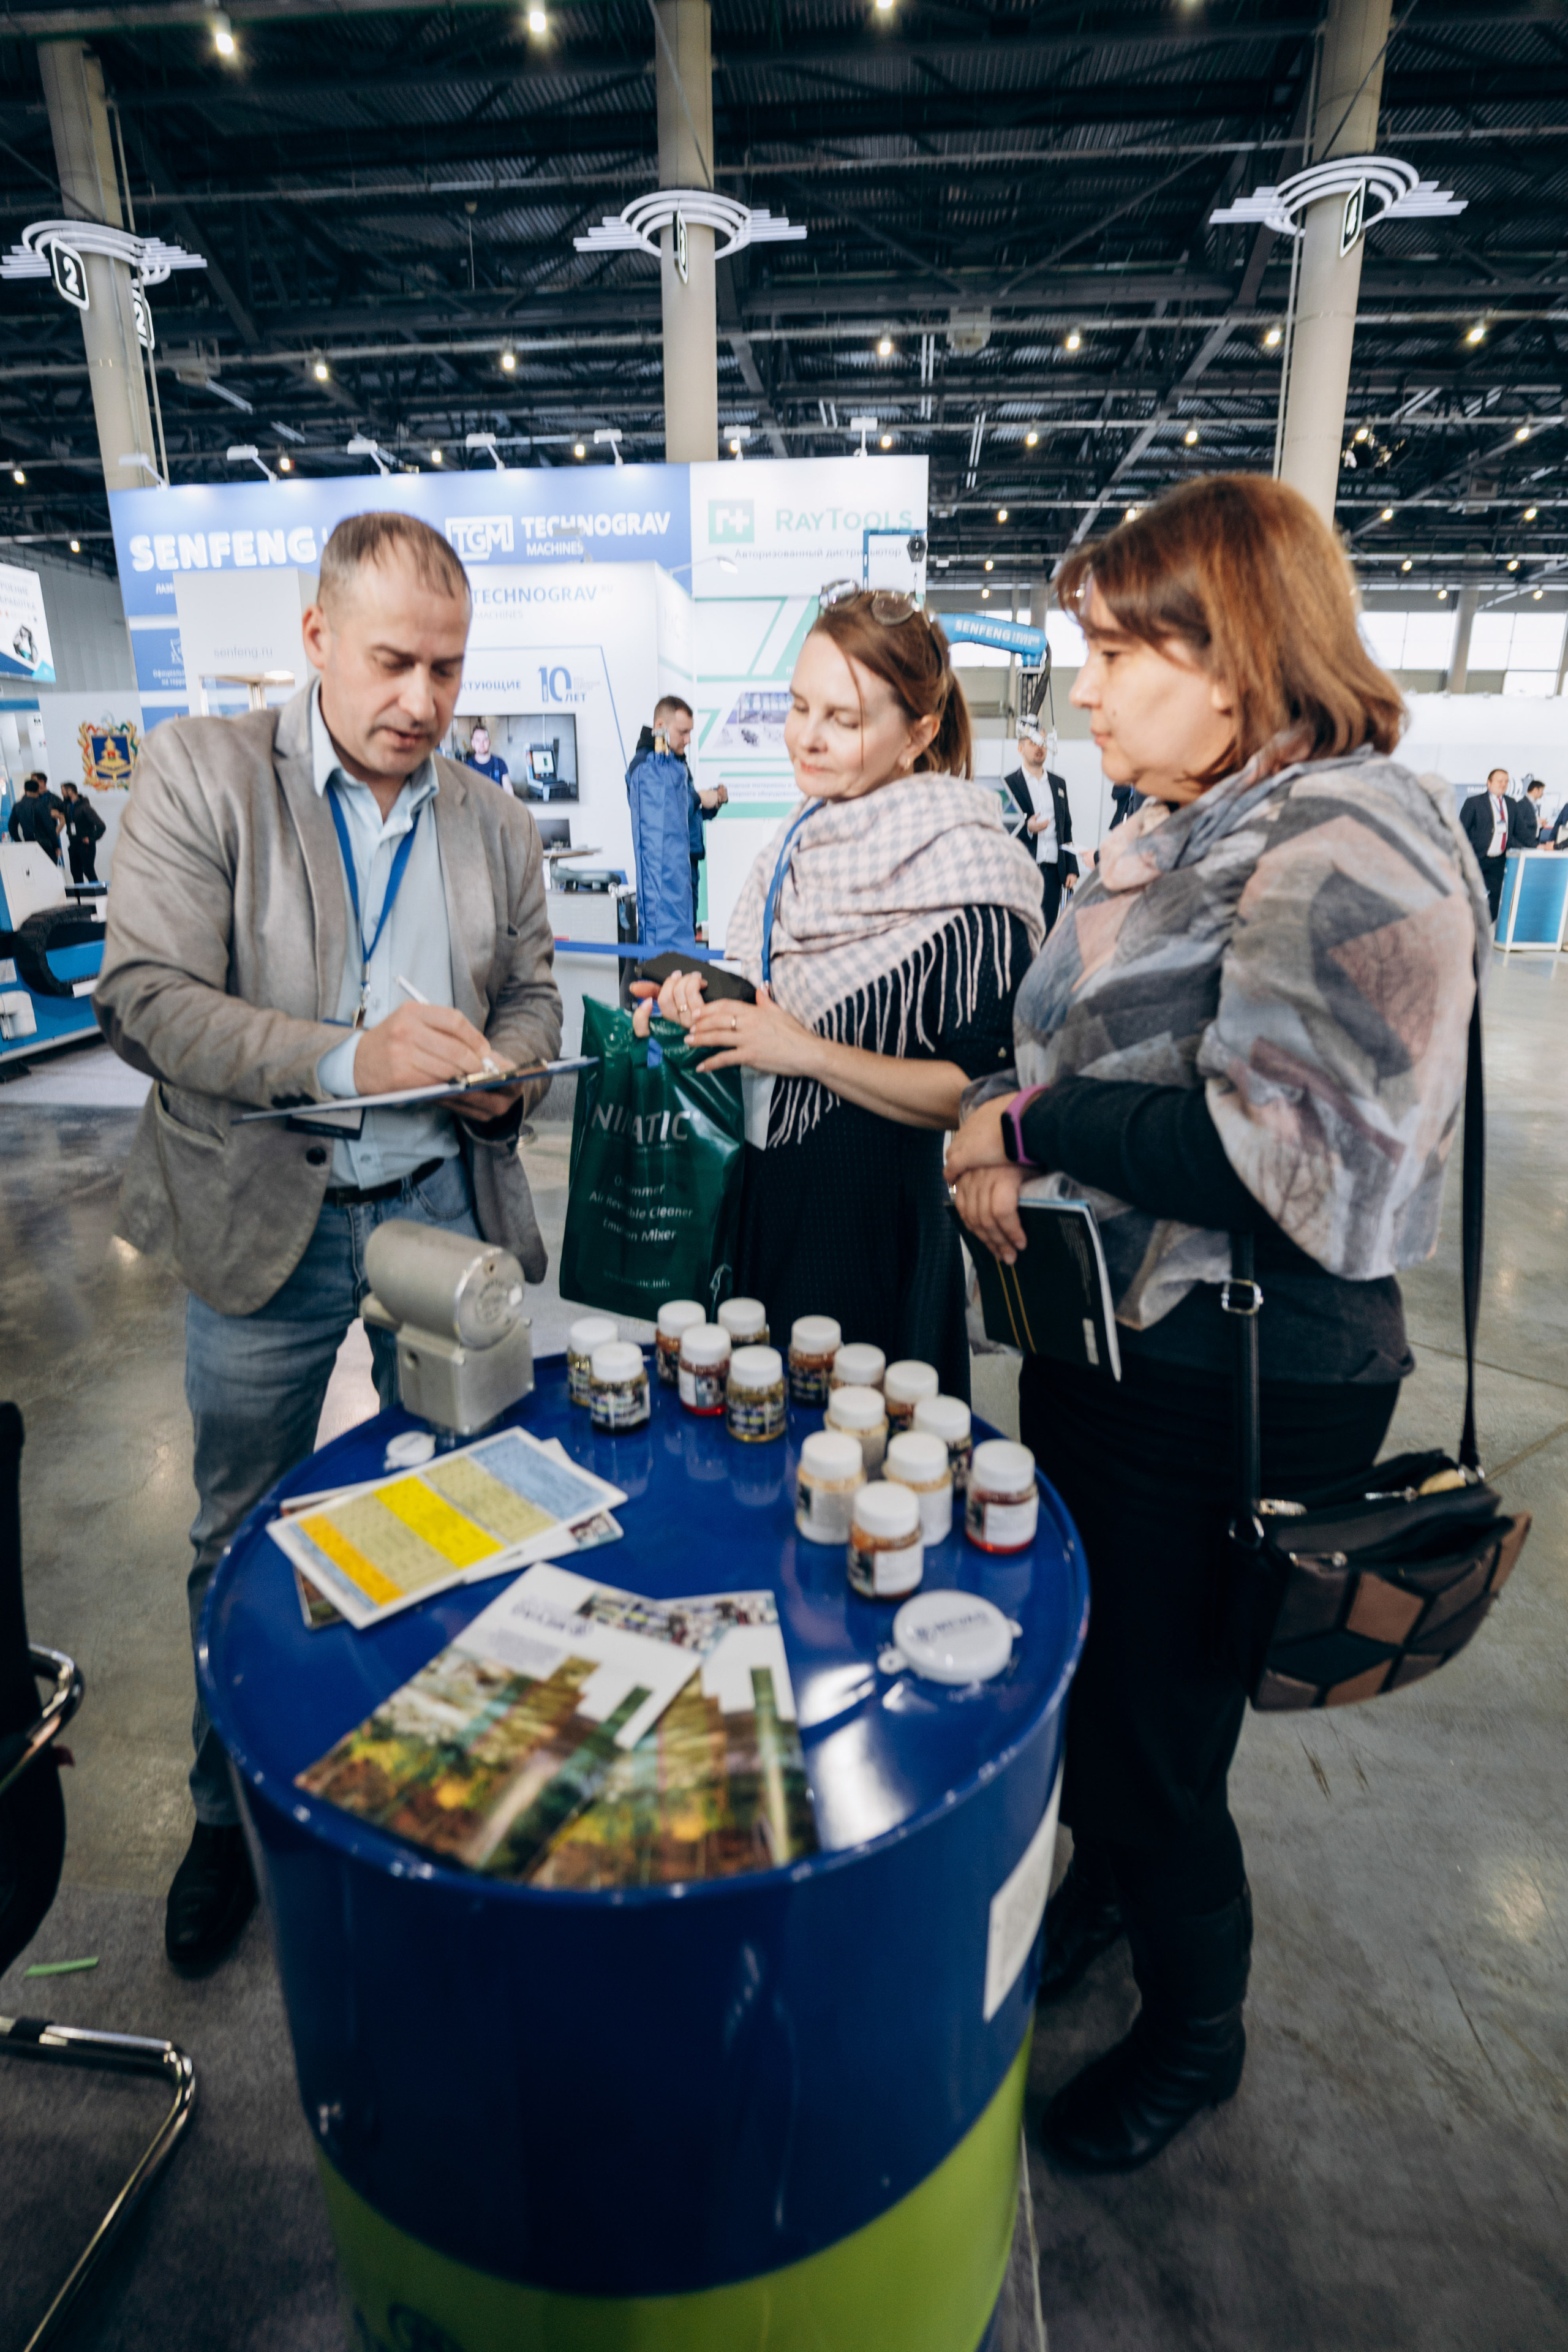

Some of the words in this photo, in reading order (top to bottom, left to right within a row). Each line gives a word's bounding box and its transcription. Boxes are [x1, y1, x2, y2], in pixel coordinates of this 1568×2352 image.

[63, 256, 80, 296] 2
[133, 300, 146, 337] 2
[521, 511, 671, 539] TECHNOGRAV
[129, 527, 317, 572] SENFENG
[526, 541, 584, 557] MACHINES
[734, 548, 823, 560] Авторизованный
[826, 547, 902, 559] дистриьютор
[472, 585, 597, 605] TECHNOGRAV
[954, 619, 1011, 643] SENFENG
[214, 646, 273, 661] senfeng.ru
[538, 666, 572, 703] 10
[564, 692, 587, 703] ЛЕТ
[589, 1190, 604, 1204] Air
[649, 1205, 693, 1220] Cleaner
[641, 1227, 677, 1243] Mixer
